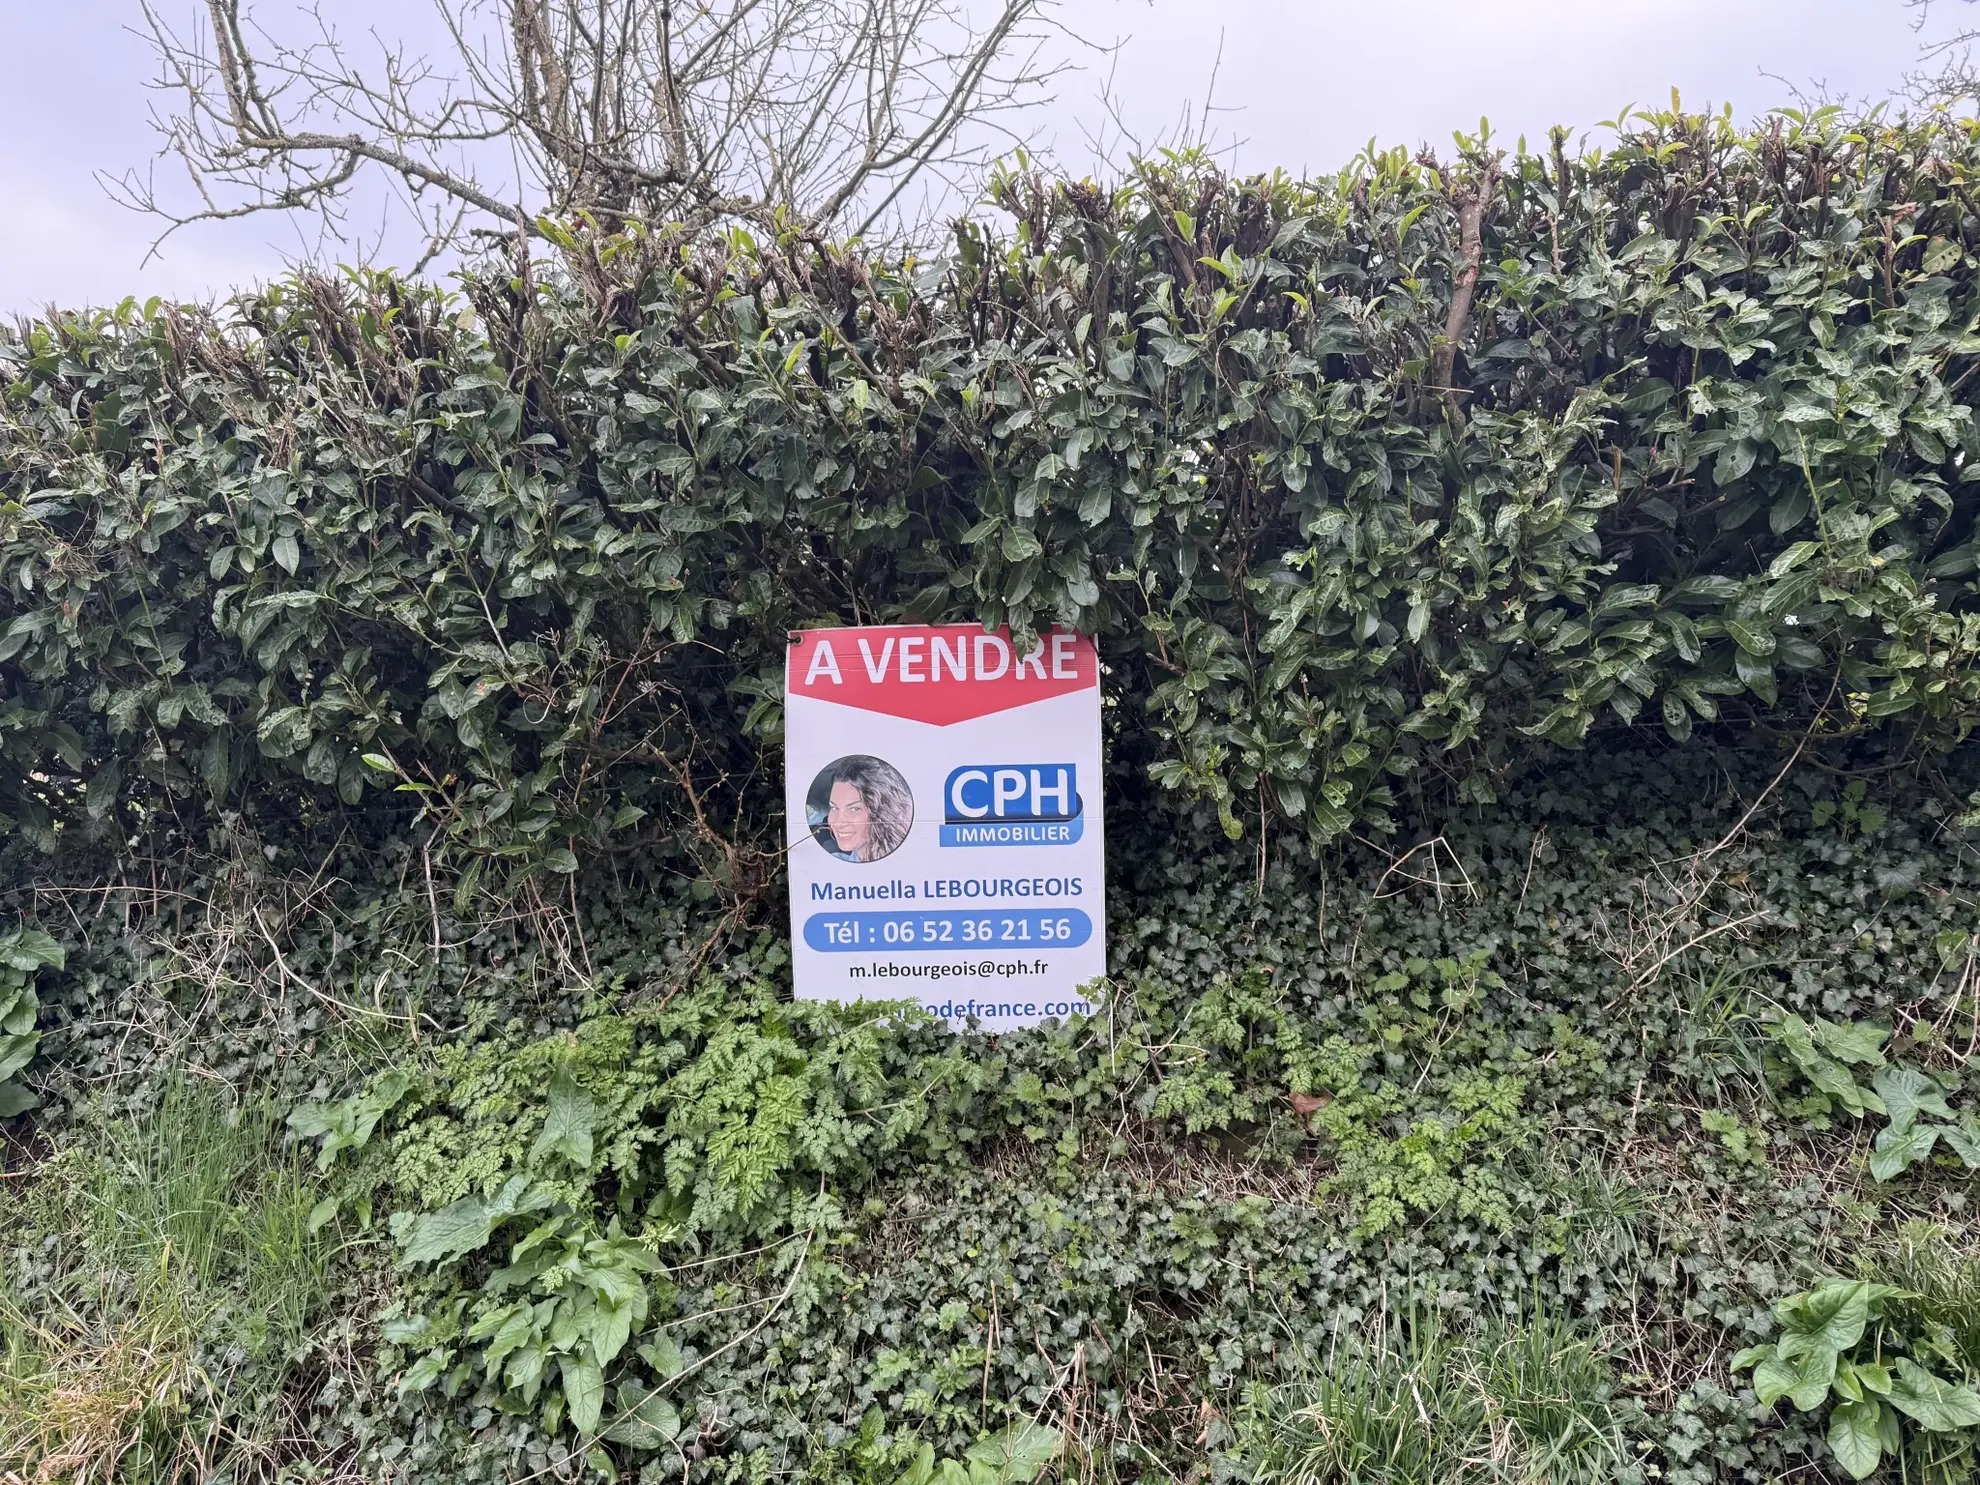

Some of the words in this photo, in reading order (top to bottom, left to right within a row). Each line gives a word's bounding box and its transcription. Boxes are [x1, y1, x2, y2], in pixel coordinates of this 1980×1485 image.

[805, 640, 843, 685] A
[858, 634, 1078, 684] VENDRE
[951, 768, 1069, 818] CPH
[956, 826, 1070, 842] IMMOBILIER
[811, 880, 916, 900] Manuella
[924, 877, 1083, 898] LEBOURGEOIS
[824, 921, 859, 944] Tél
[883, 921, 915, 943] 06
[923, 920, 953, 942] 52
[962, 919, 993, 941] 36
[1001, 918, 1031, 941] 21
[1040, 918, 1071, 940] 56
[849, 959, 1049, 980] m.lebourgeois@cph.fr
[898, 999, 1091, 1017] odefrance.com
